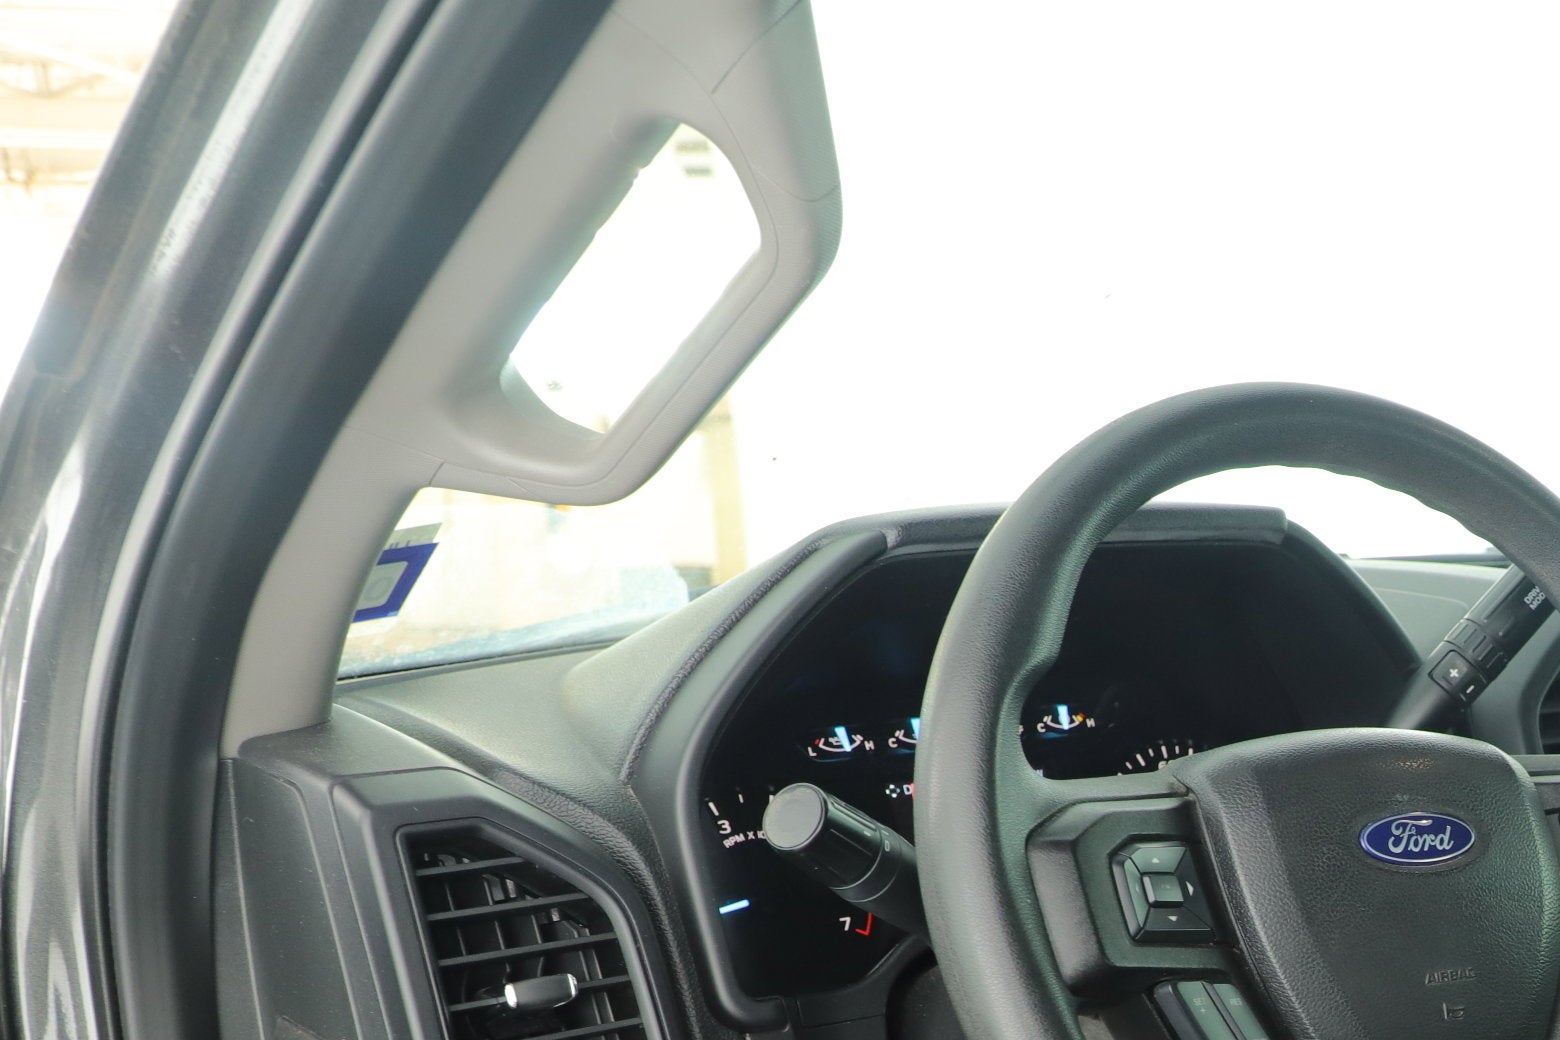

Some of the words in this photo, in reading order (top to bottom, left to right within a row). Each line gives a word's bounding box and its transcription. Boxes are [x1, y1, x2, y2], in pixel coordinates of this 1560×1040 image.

[1523, 585, 1540, 605] DRIV
[1529, 591, 1546, 611] MOD
[1036, 722, 1046, 733] C
[1086, 717, 1096, 728] H
[864, 739, 875, 751] H
[887, 737, 898, 749] C
[808, 746, 818, 757] L
[717, 819, 732, 835] 3
[722, 832, 746, 849] RPM
[746, 831, 756, 840] X
[1387, 819, 1455, 854] Ford
[839, 916, 851, 931] 7
[1424, 966, 1477, 986] AIRBAG
[1192, 997, 1206, 1007] SET
[1229, 997, 1243, 1007] RES
